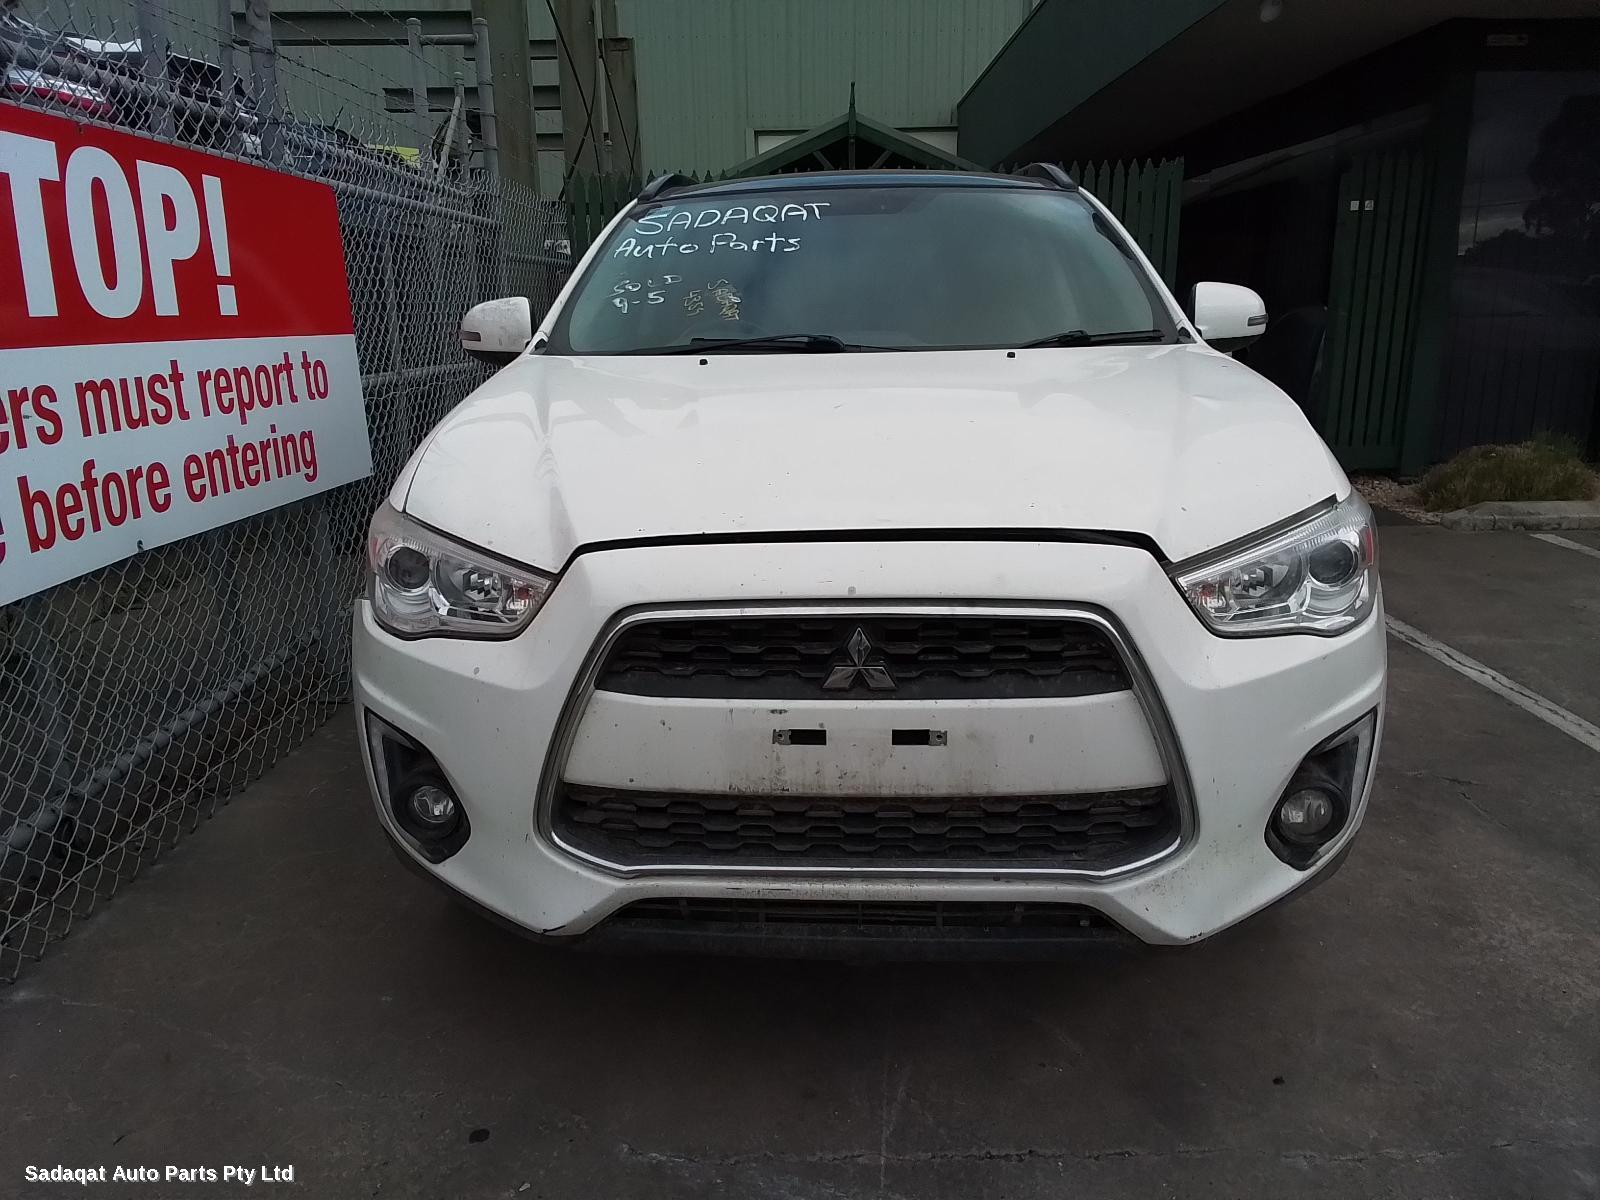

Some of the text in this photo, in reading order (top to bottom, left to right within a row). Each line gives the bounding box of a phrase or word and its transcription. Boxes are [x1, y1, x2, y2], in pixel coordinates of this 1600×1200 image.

[0, 131, 239, 319] TOP!
[614, 232, 801, 258] Auto Parts
[635, 203, 830, 235] SADAQAT
[75, 359, 190, 438] must
[197, 351, 298, 425] report
[300, 352, 329, 401] to
[17, 458, 172, 554] before
[183, 423, 318, 503] entering
